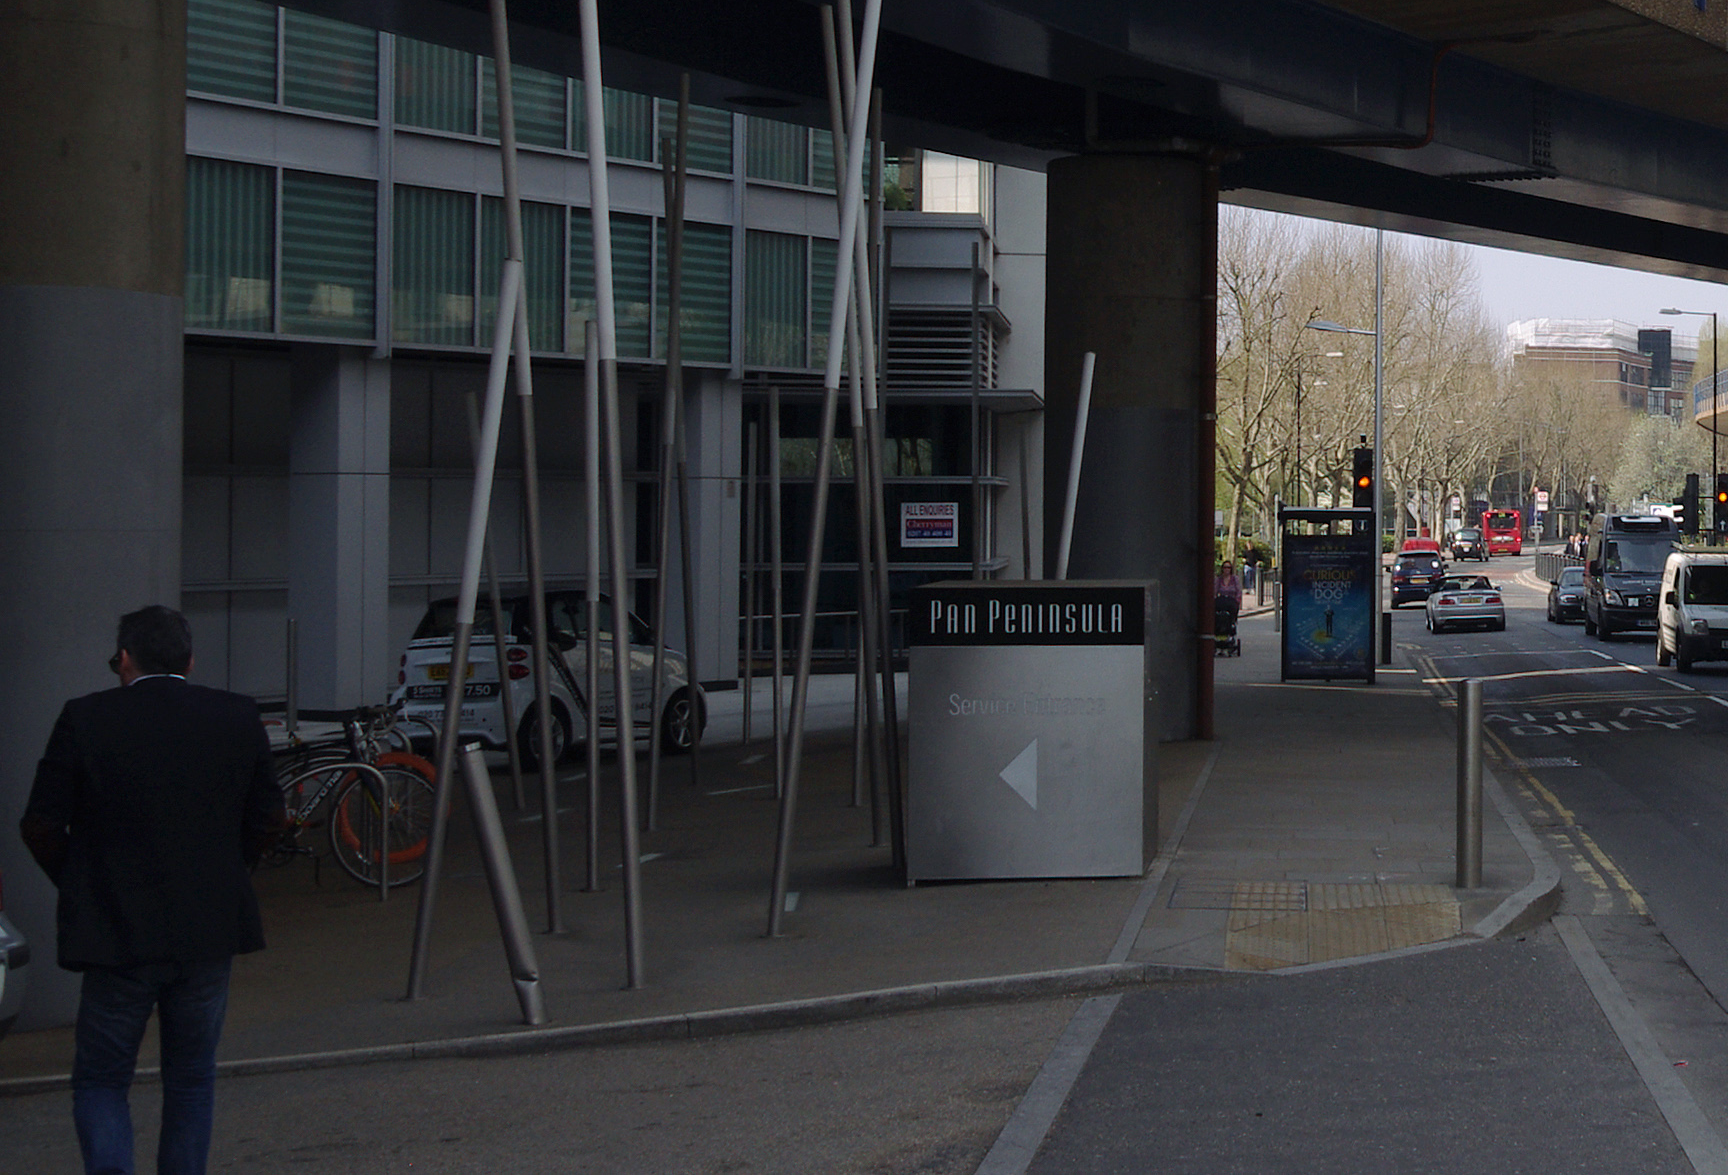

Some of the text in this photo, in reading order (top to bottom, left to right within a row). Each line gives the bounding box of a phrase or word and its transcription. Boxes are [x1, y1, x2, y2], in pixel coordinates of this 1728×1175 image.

[905, 504, 954, 515] ALL ENQUIRIES
[1314, 588, 1344, 600] DOG
[949, 693, 1016, 716] Service
[1483, 704, 1697, 724] AHEAD
[1509, 717, 1696, 735] ONLY
